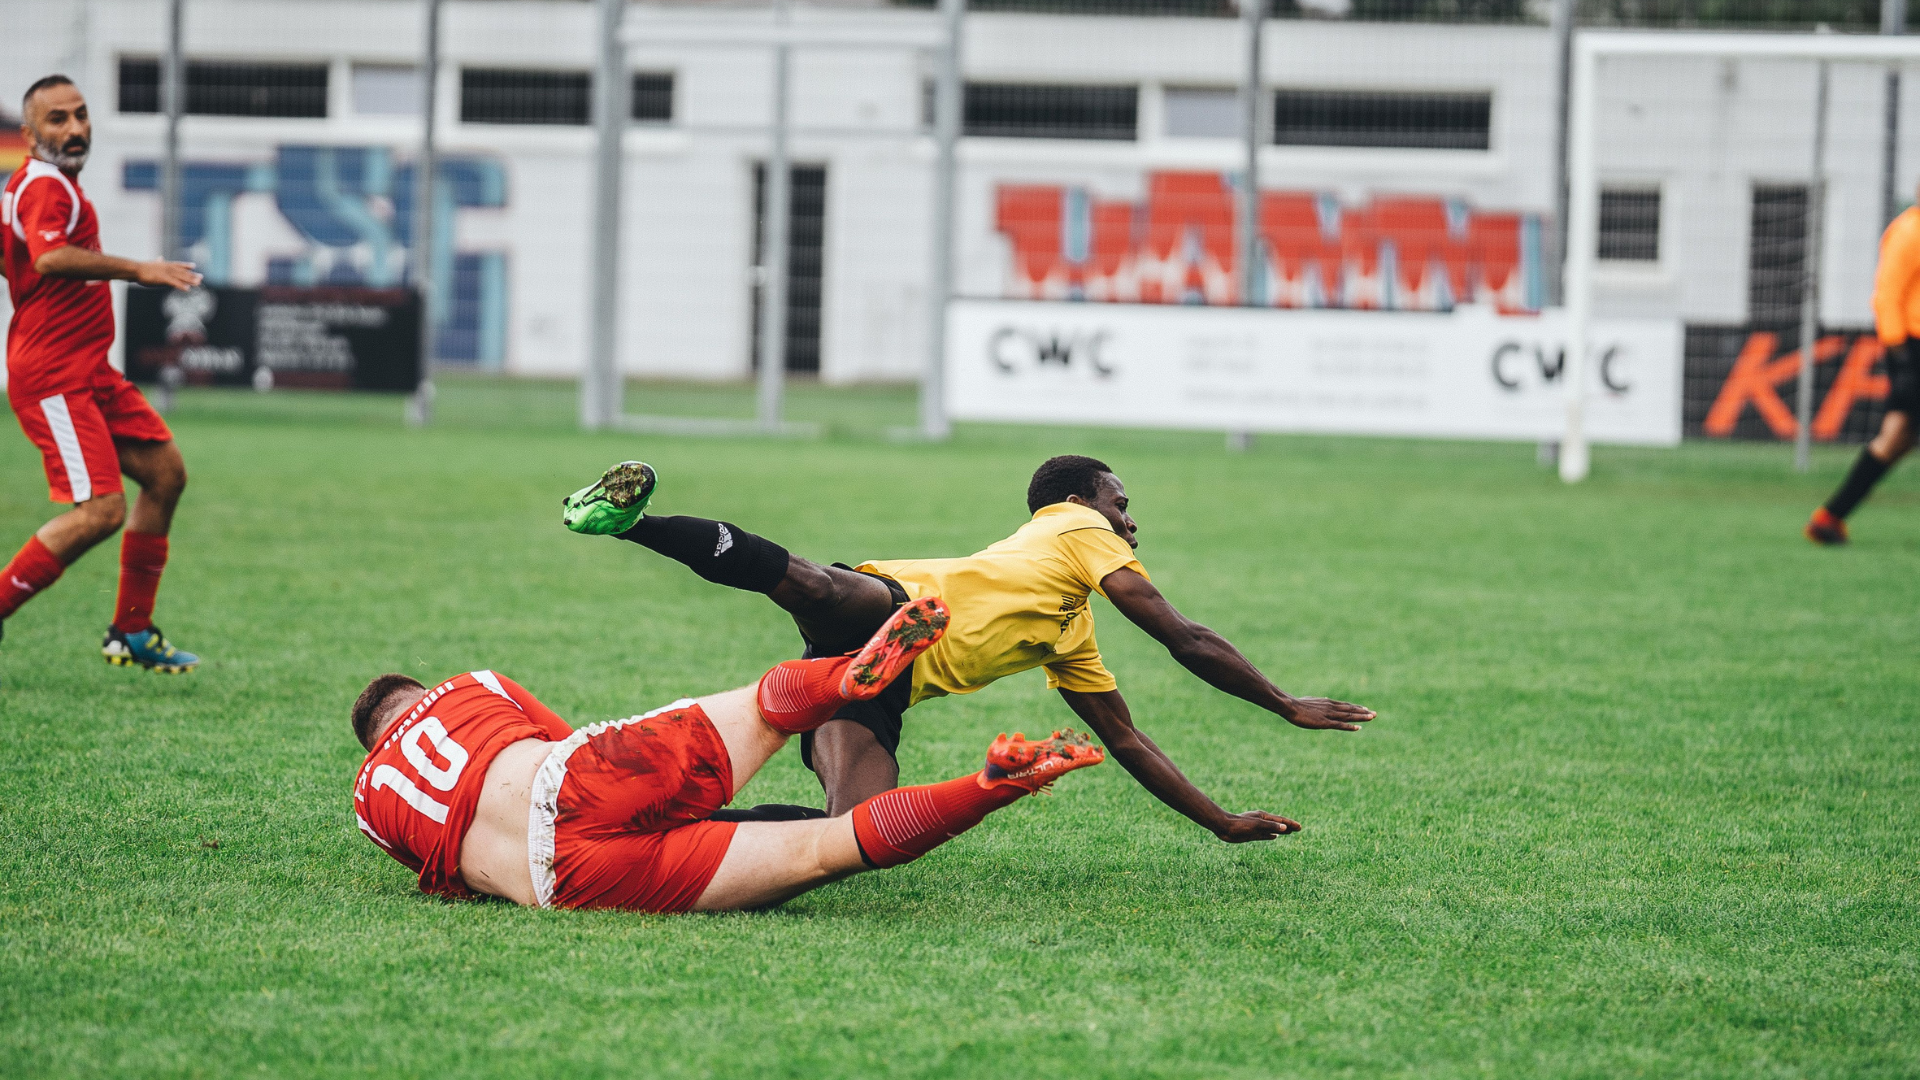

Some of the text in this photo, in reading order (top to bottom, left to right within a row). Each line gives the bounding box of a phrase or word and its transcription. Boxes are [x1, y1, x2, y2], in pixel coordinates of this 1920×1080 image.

[986, 326, 1118, 380] CWC
[371, 716, 470, 825] 10
[1007, 760, 1054, 780] ULTRA
